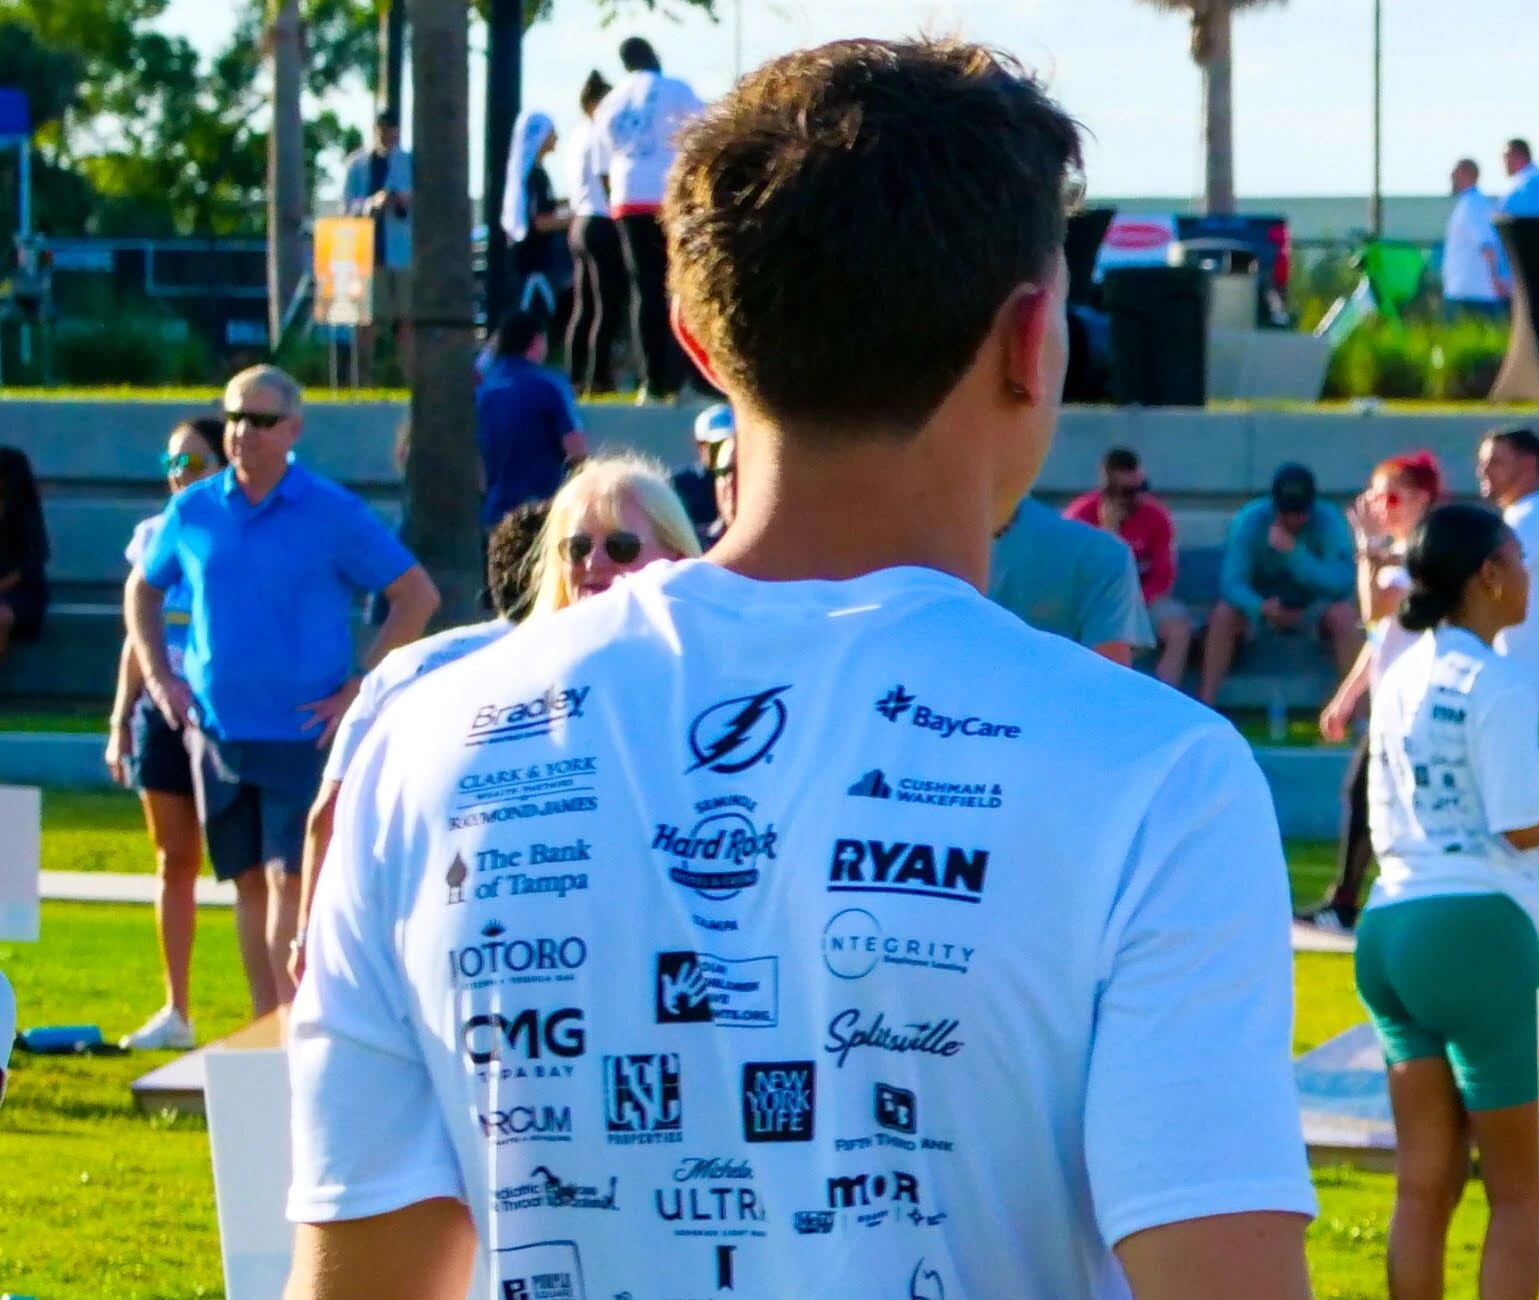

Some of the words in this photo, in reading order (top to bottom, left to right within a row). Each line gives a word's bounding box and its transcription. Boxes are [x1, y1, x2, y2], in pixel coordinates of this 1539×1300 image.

[471, 684, 591, 729] Bradley
[912, 704, 1023, 738] BayCare
[458, 768, 522, 789] CLARK
[527, 765, 540, 779] &
[546, 757, 597, 775] YORK
[896, 790, 1002, 809] WAKEFIELD
[899, 778, 986, 794] CUSHMAN
[991, 784, 1003, 795] &
[540, 796, 598, 815] JAMES
[476, 849, 522, 871] The
[529, 838, 592, 865] Bank
[652, 823, 727, 860] Hard
[726, 823, 777, 865] Rock
[829, 838, 990, 893] RYAN
[475, 876, 503, 899] of
[508, 873, 588, 898] Tampa
[824, 935, 975, 962] NTEGRITY
[536, 1065, 574, 1080] BAY
[755, 1070, 808, 1092] NEW
[746, 1089, 811, 1112] YORK
[753, 1110, 804, 1132] LIFE
